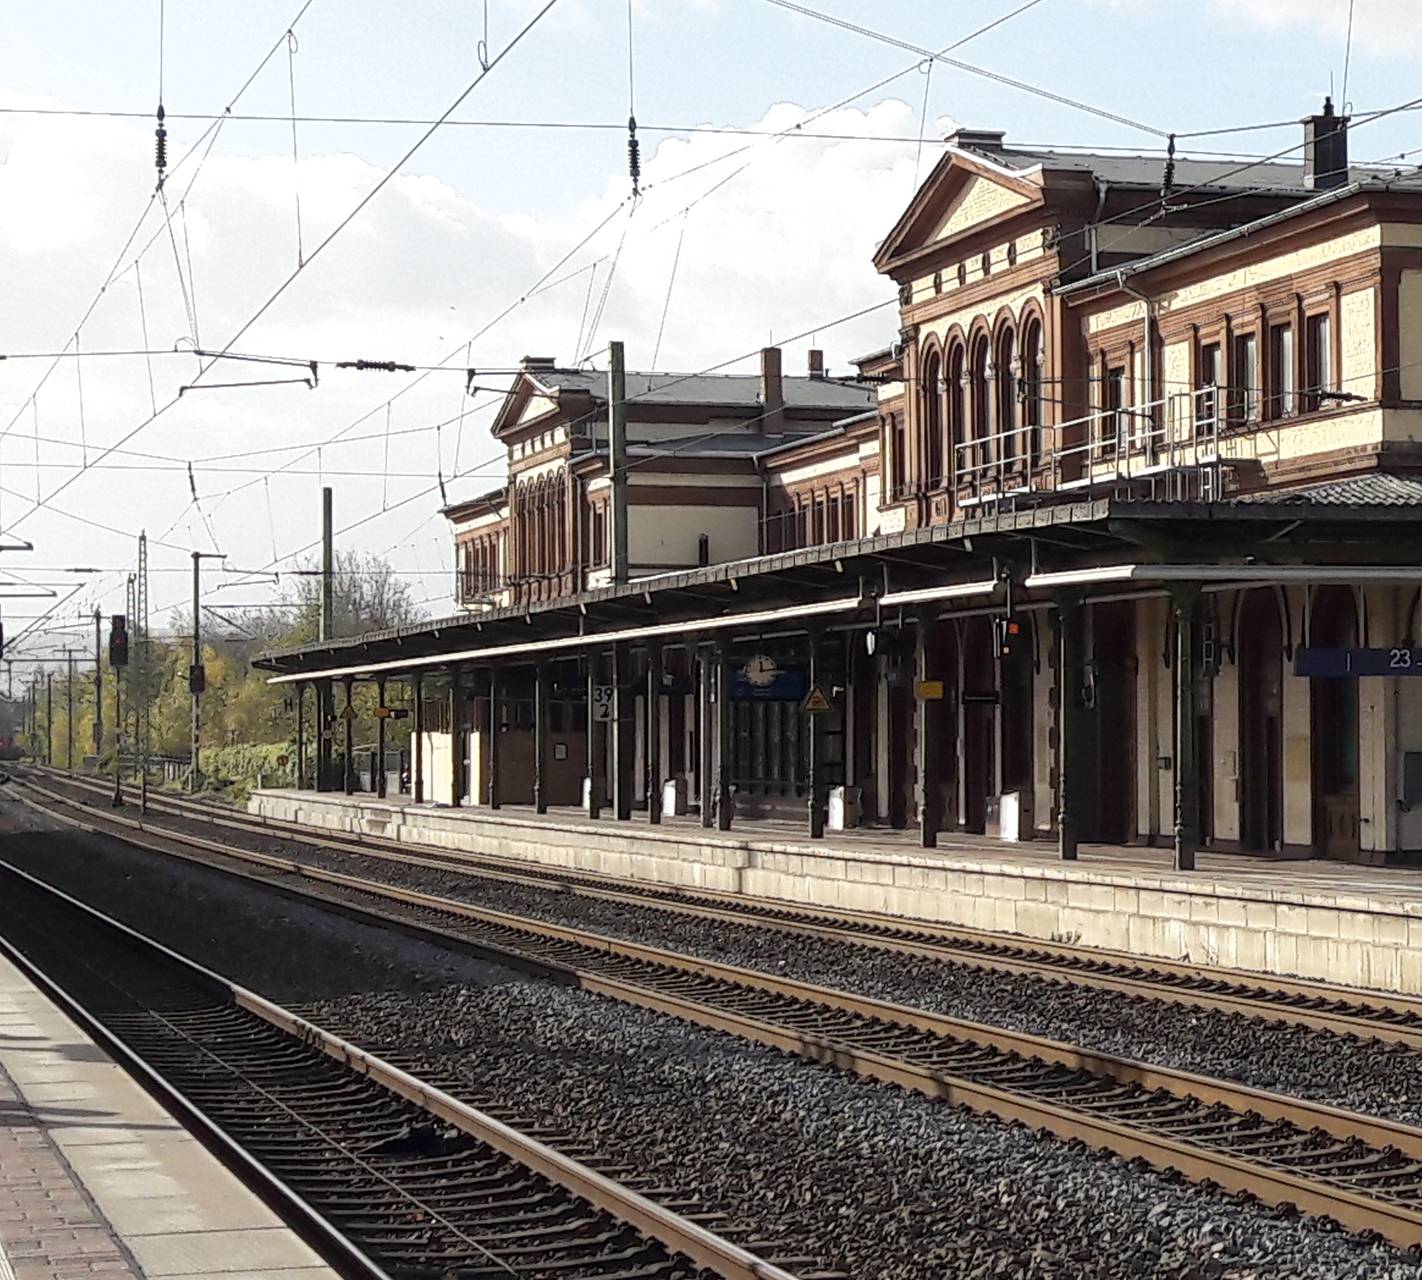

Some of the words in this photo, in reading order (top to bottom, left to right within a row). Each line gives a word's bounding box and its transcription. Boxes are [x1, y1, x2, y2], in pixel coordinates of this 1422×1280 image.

[1389, 649, 1411, 668] 23
[594, 687, 613, 702] 39
[600, 703, 609, 718] 2
